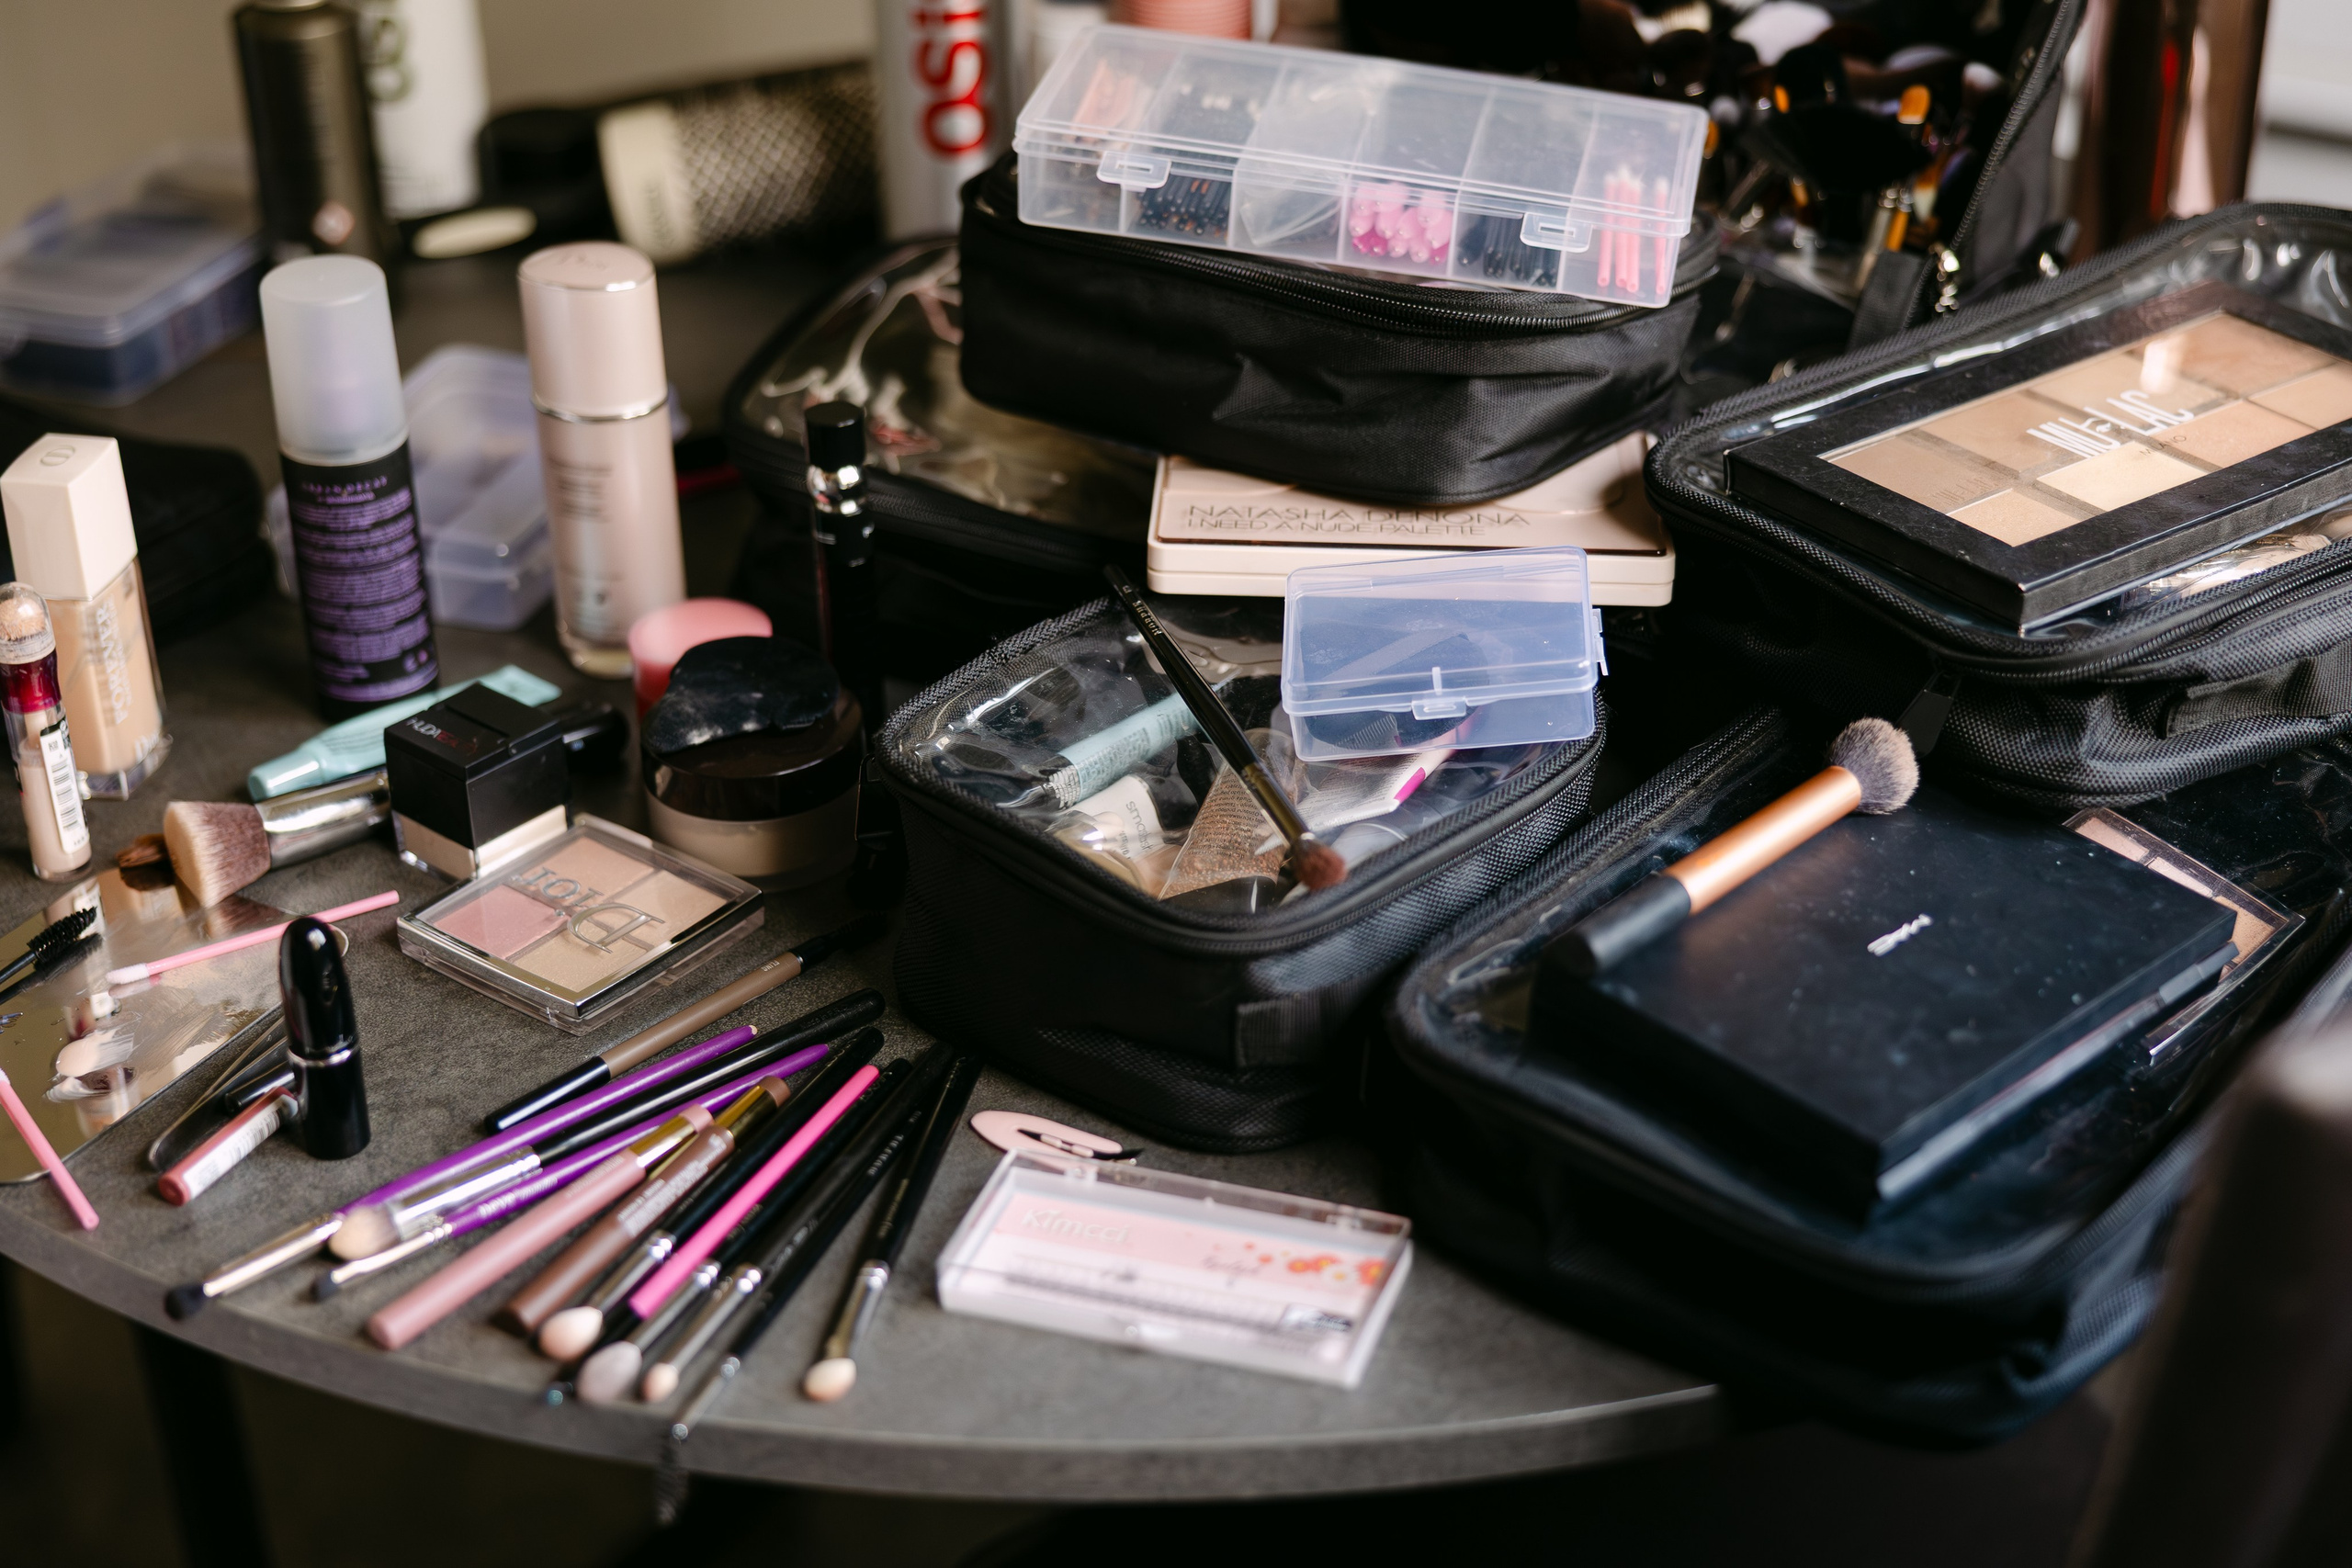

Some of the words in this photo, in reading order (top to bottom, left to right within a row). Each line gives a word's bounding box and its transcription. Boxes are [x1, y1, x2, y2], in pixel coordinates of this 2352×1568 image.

[1188, 505, 1354, 521] NATASHA
[1366, 509, 1530, 526] DENONA
[1199, 519, 1269, 530] NEED
[1274, 522, 1294, 531] A
[1300, 522, 1373, 533] NUDE
[1379, 525, 1486, 536] PALETTE
[96, 601, 128, 725] FOREVER
[509, 866, 665, 954] Dior
